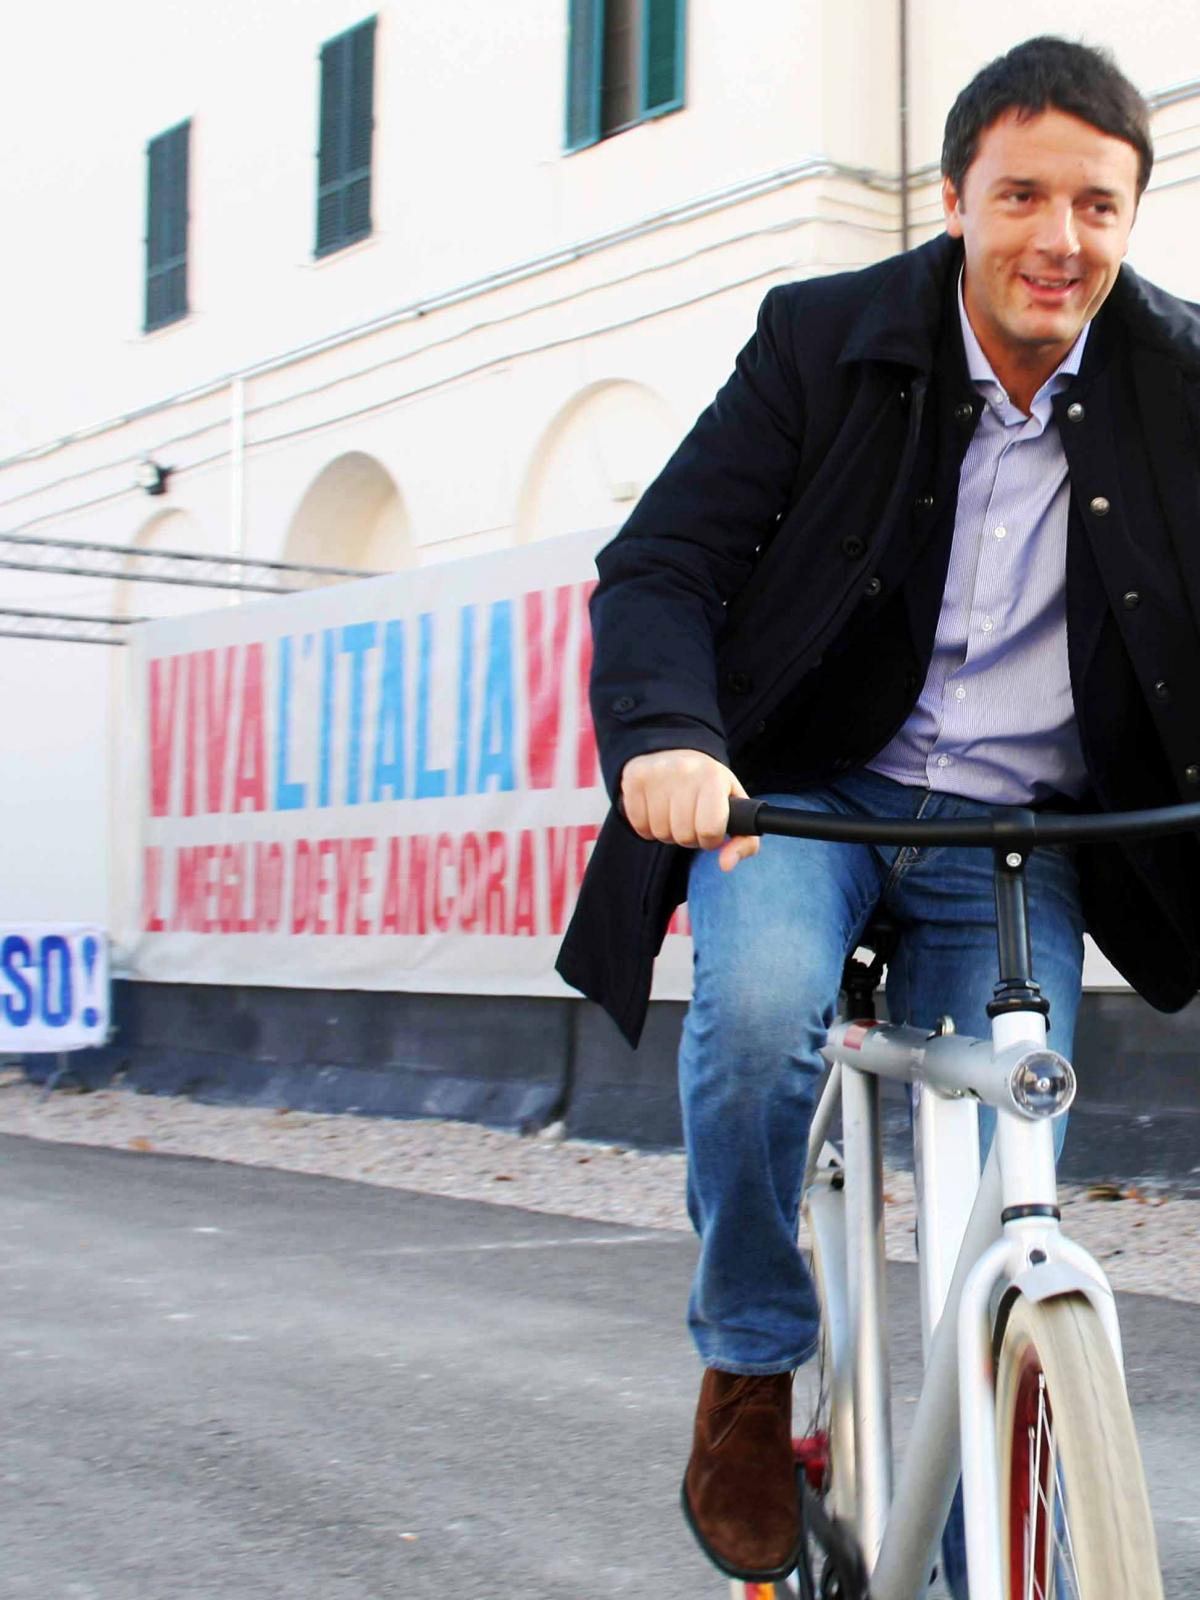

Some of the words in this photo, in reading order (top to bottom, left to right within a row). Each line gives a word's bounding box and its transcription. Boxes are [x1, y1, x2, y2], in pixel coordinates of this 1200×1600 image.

[149, 642, 266, 816] VIVA
[273, 600, 516, 812] L'ITALIA
[290, 836, 374, 936] DEVE
[380, 829, 537, 936] ANCORA
